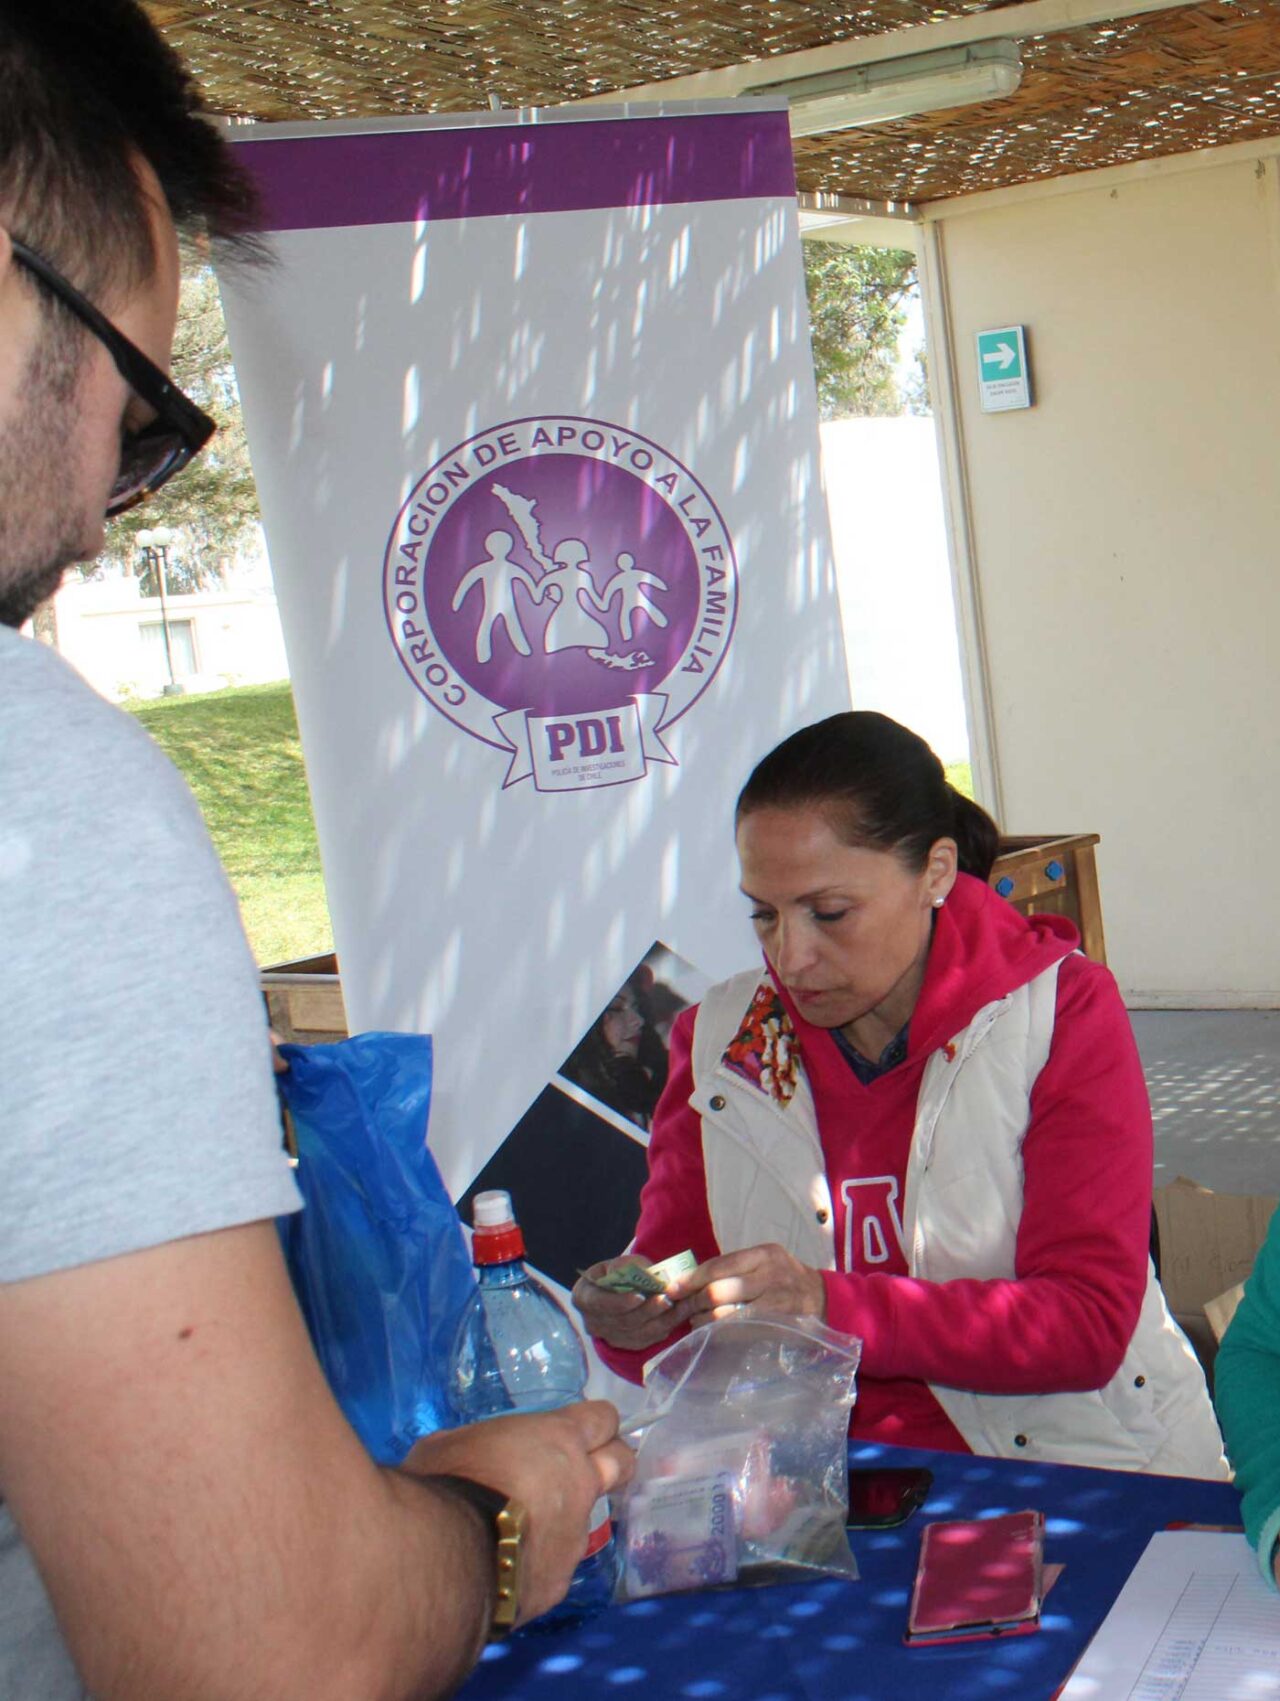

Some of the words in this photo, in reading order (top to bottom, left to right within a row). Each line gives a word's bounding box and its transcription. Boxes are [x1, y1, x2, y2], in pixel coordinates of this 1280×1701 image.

[473, 433, 521, 467] DE
[531, 426, 654, 471] APOYO
[655, 472, 678, 495] A
[678, 494, 711, 538] LA
[395, 461, 470, 706] CORPORACION
[681, 544, 727, 675] FAMILIA
[545, 716, 624, 761] PDI
